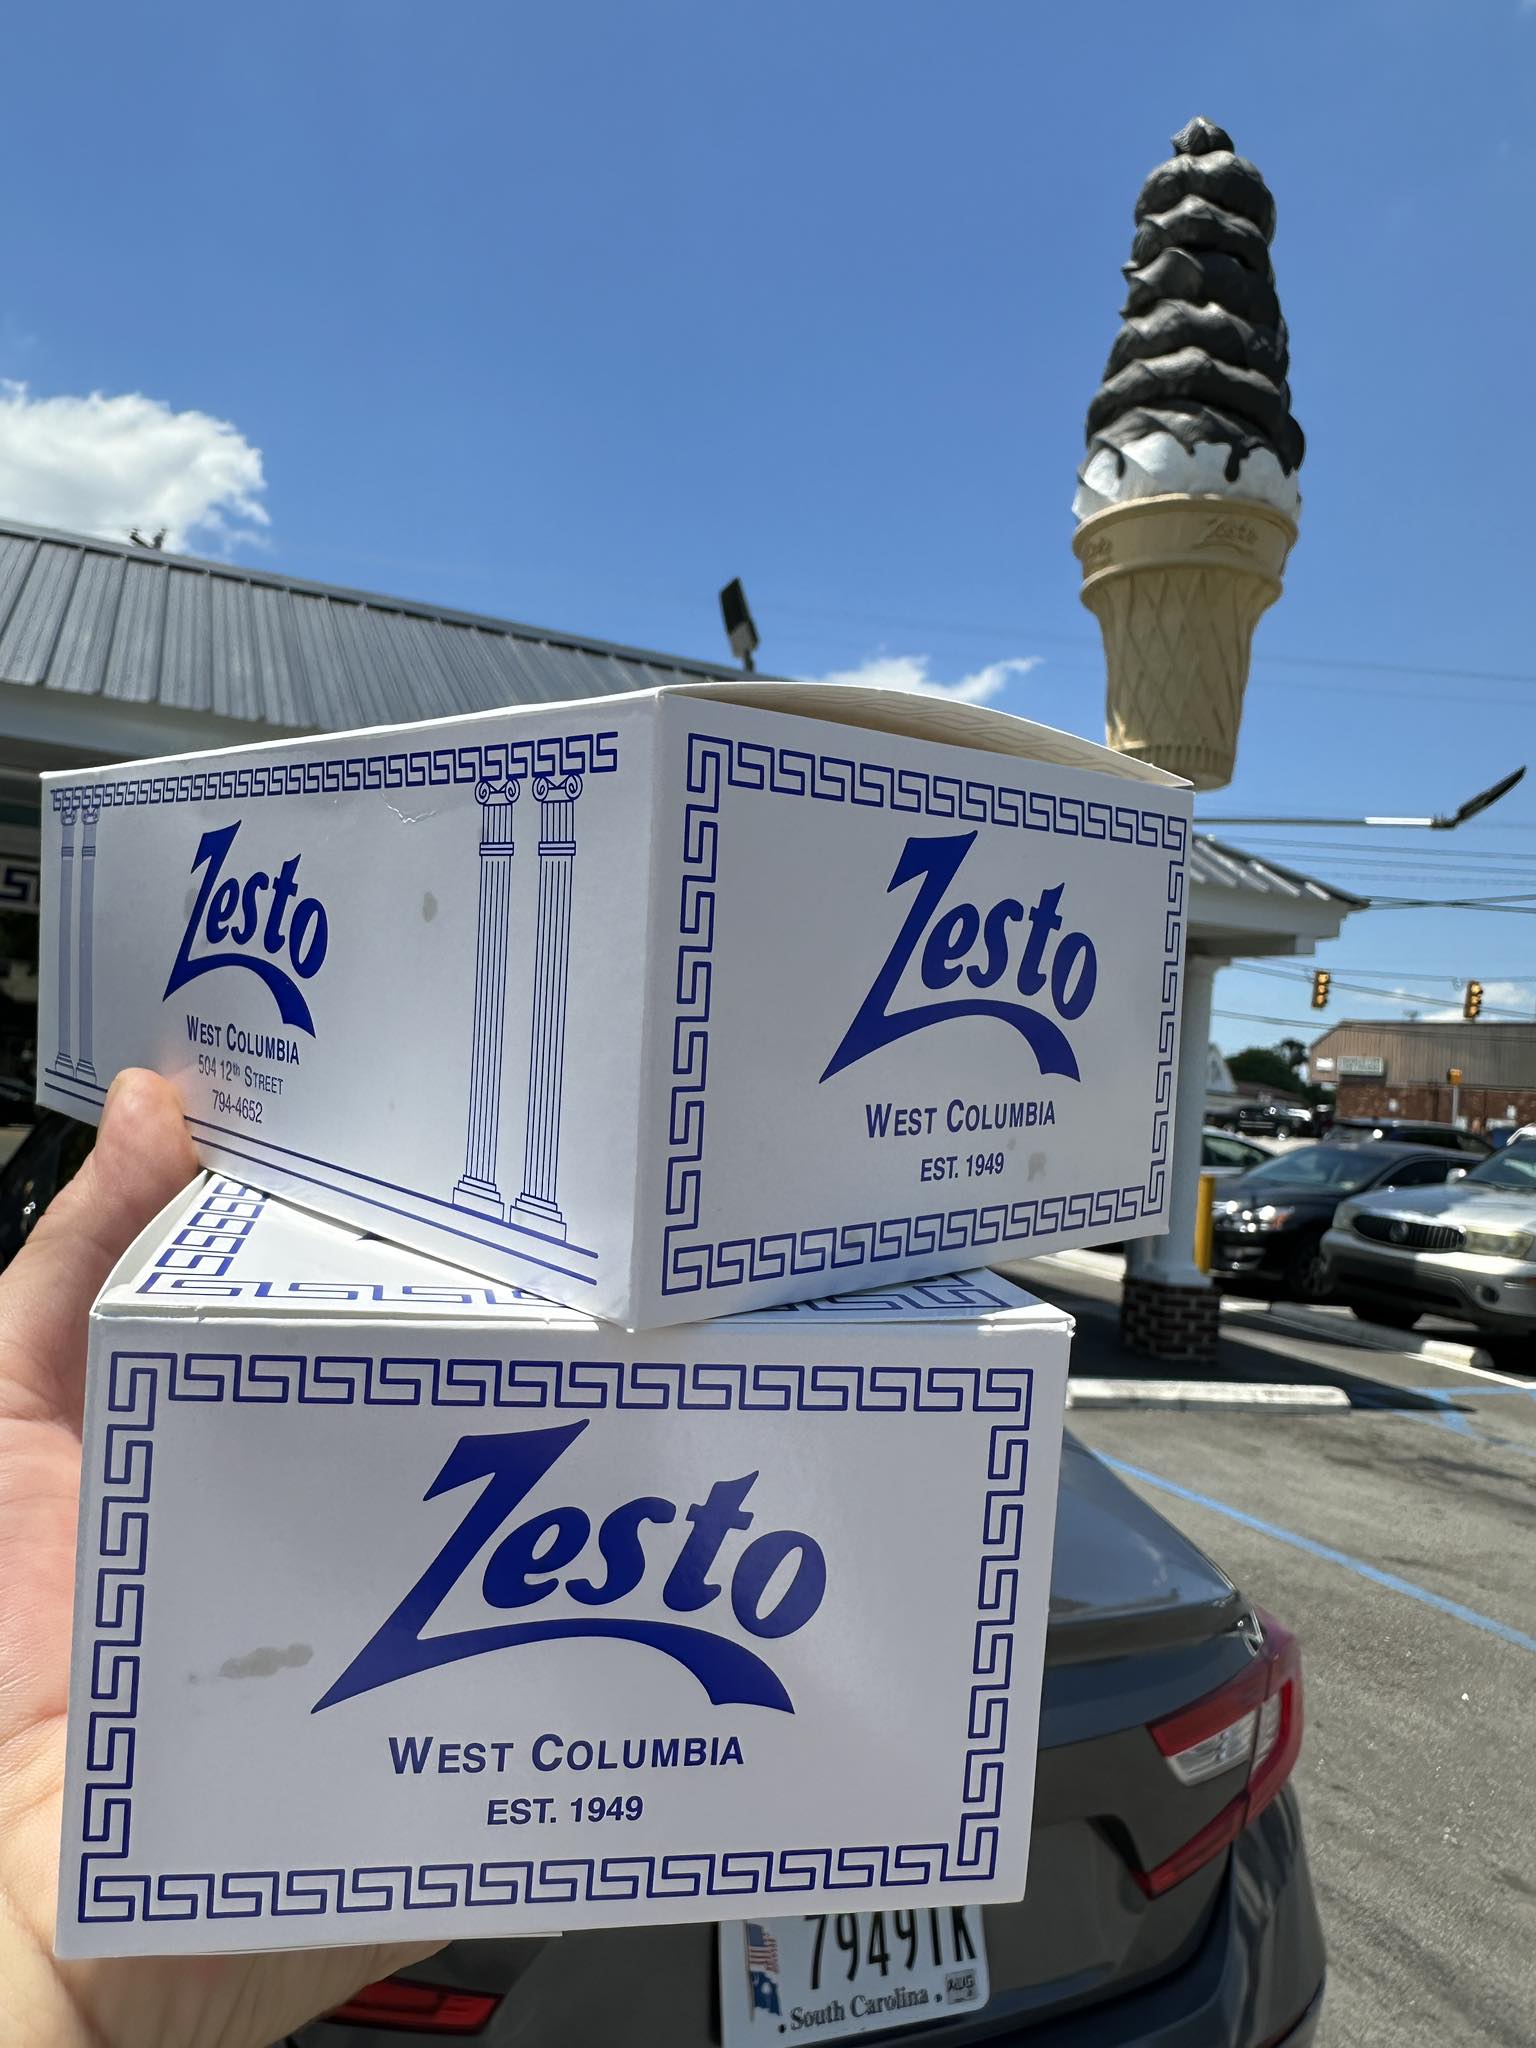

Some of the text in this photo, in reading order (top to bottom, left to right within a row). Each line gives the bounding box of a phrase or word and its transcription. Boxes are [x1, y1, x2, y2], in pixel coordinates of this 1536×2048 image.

[163, 819, 329, 1039] Zesto
[818, 830, 1098, 1085] Zesto
[186, 1014, 300, 1066] WEST COLUMBIA
[198, 1054, 284, 1096] 504 12th STREET
[212, 1088, 263, 1125] 794-4652
[865, 1098, 1056, 1139] WEST COLUMBIA
[920, 1151, 1005, 1183] EST. 1949
[310, 1418, 827, 1715] Zesto
[388, 1733, 745, 1775] WEST COLUMBIA
[486, 1795, 645, 1826] EST. 1949
[789, 1985, 930, 2032] South Carolina
